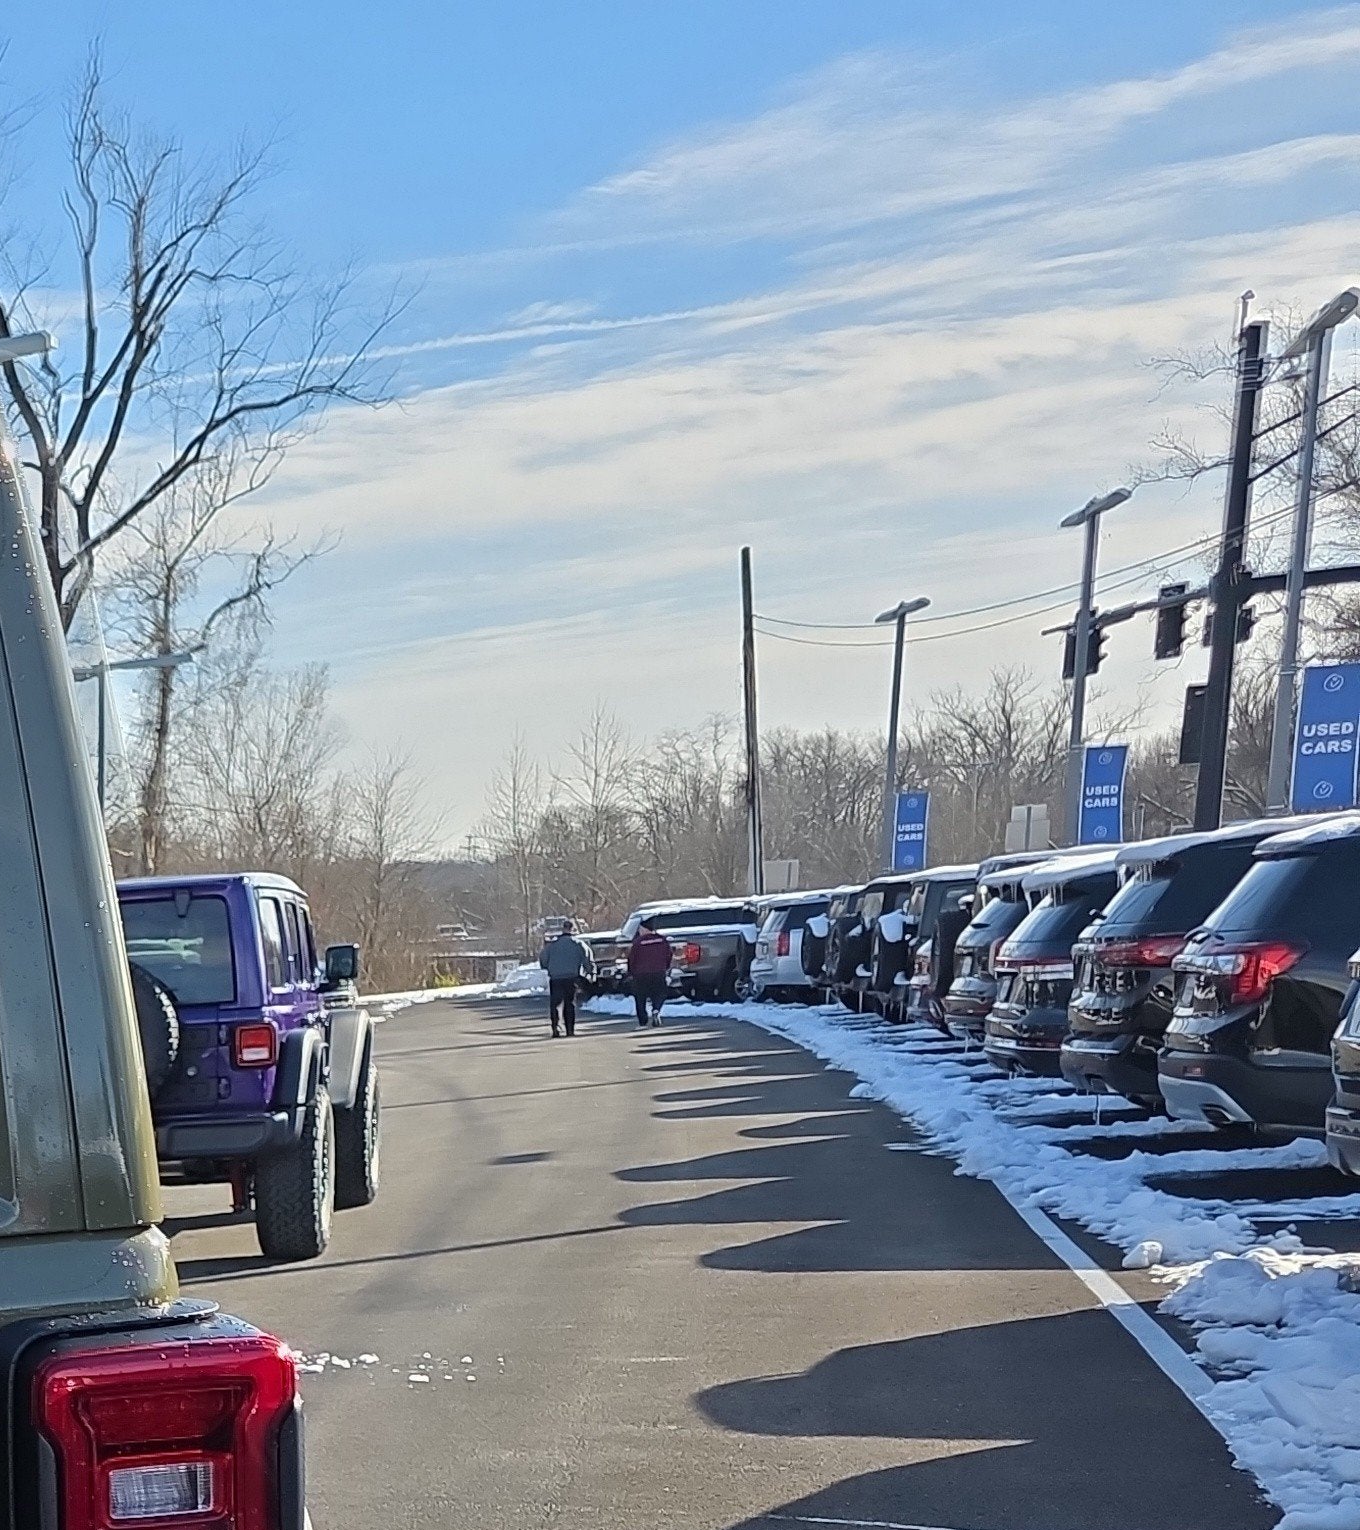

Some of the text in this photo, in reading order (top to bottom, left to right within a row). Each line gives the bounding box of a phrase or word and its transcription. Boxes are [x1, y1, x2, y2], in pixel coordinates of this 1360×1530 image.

[1302, 721, 1355, 738] USED
[1301, 738, 1353, 755] CARS
[1085, 783, 1120, 796] USED
[1084, 796, 1119, 809] CARS
[897, 822, 924, 833] USED
[896, 833, 924, 842] CARS
